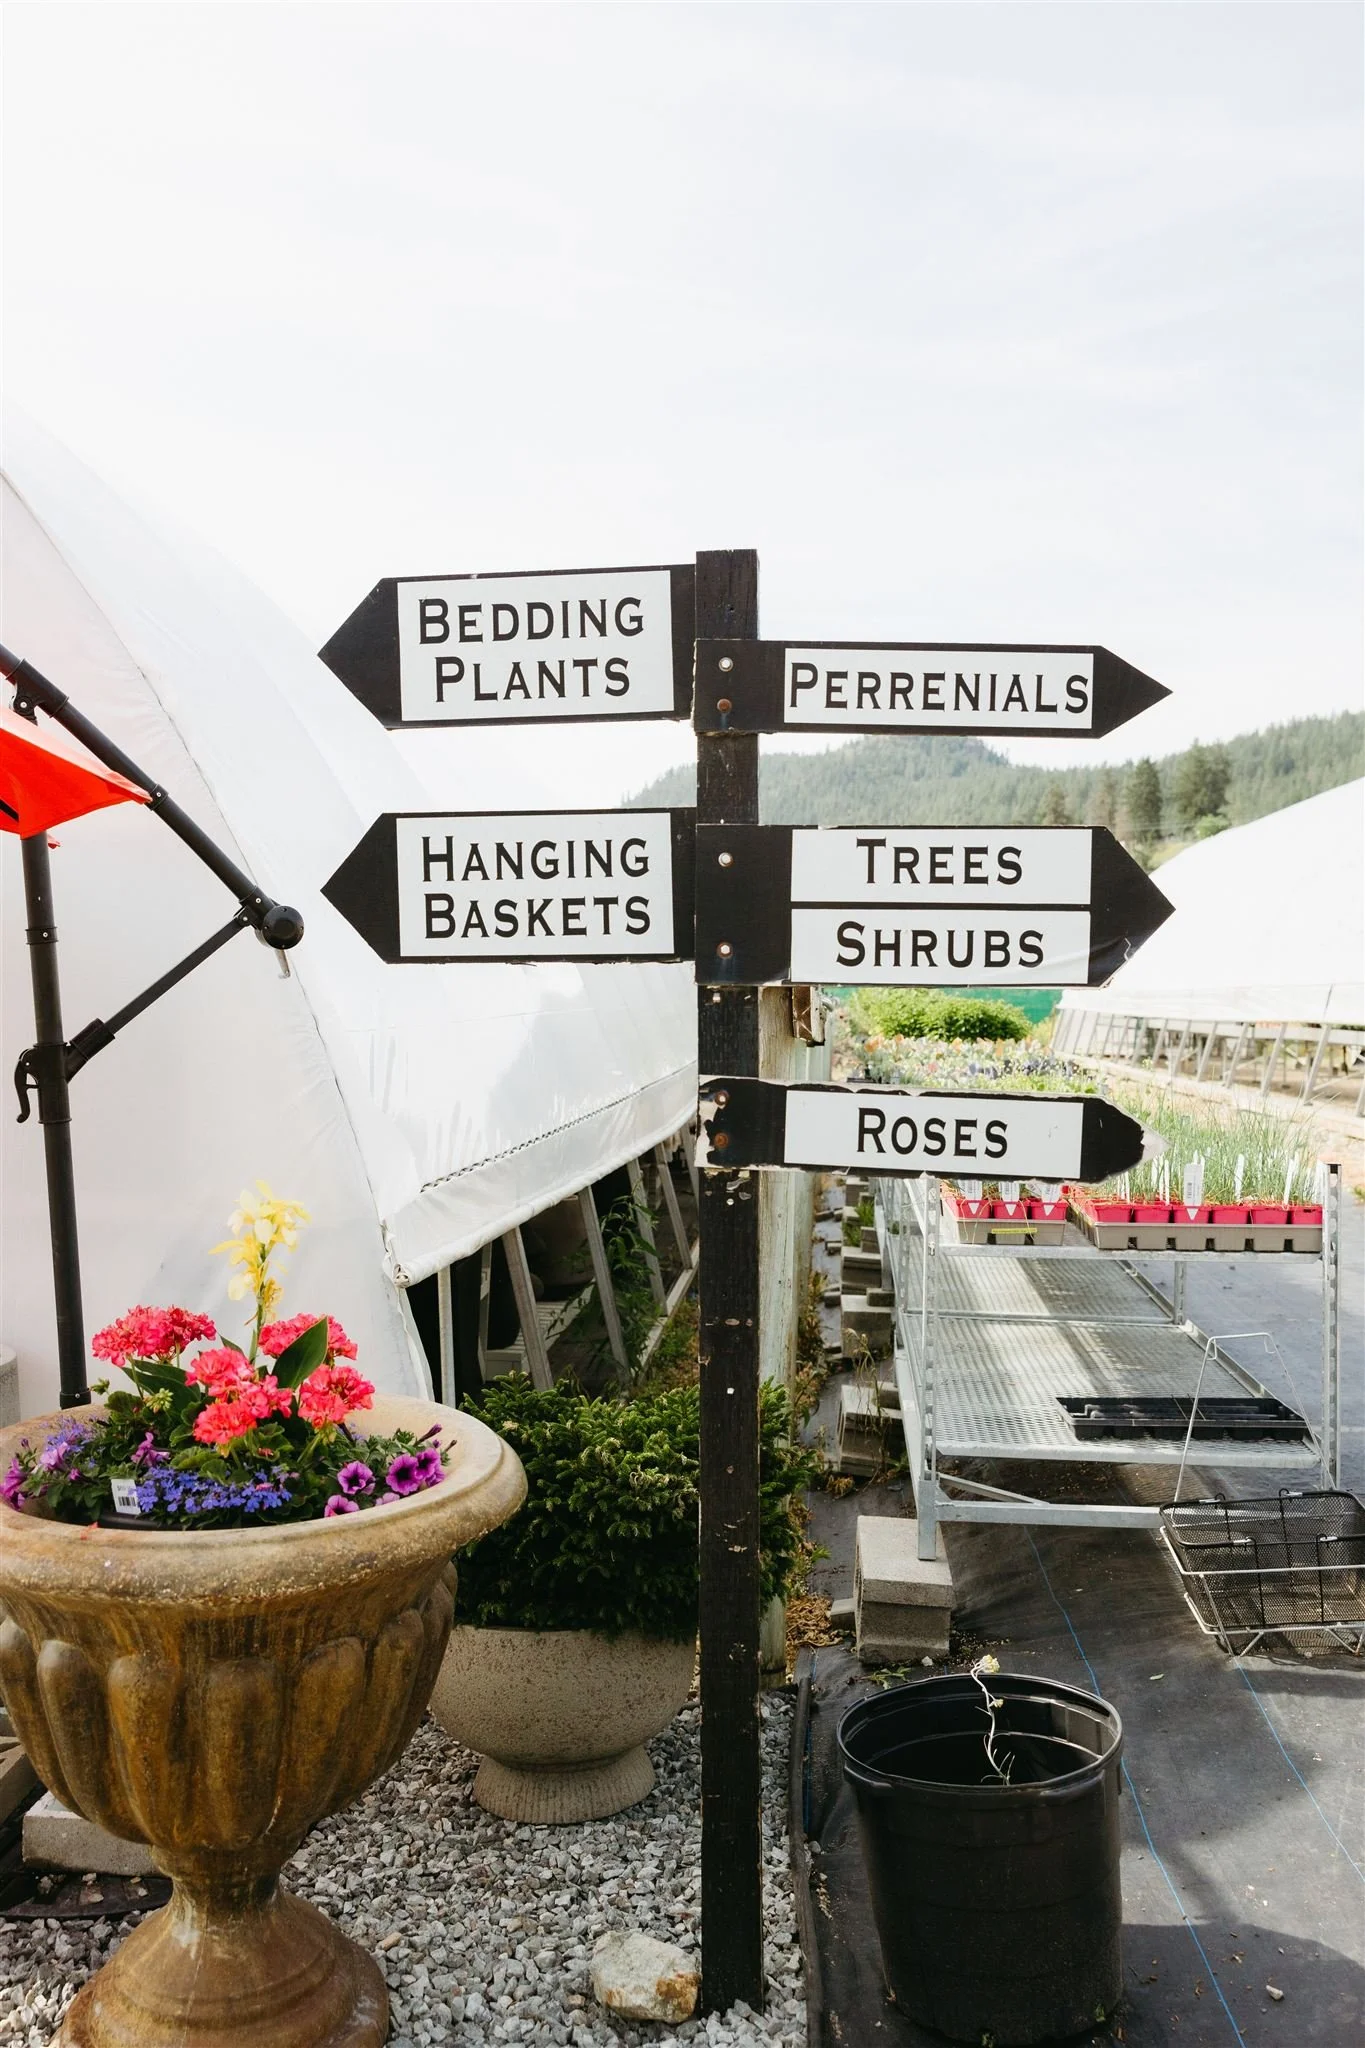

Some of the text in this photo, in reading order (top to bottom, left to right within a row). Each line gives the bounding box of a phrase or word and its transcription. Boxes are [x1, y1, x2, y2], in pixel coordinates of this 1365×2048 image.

[419, 597, 644, 645] BEDDING
[436, 657, 630, 703] PLANTS
[790, 662, 1089, 714] PERRENIALS
[421, 836, 650, 882] HANGING
[856, 838, 1023, 885] TREES
[425, 893, 651, 939] BASKETS
[836, 921, 1044, 968] SHRUBS
[857, 1107, 1008, 1159] ROSES
